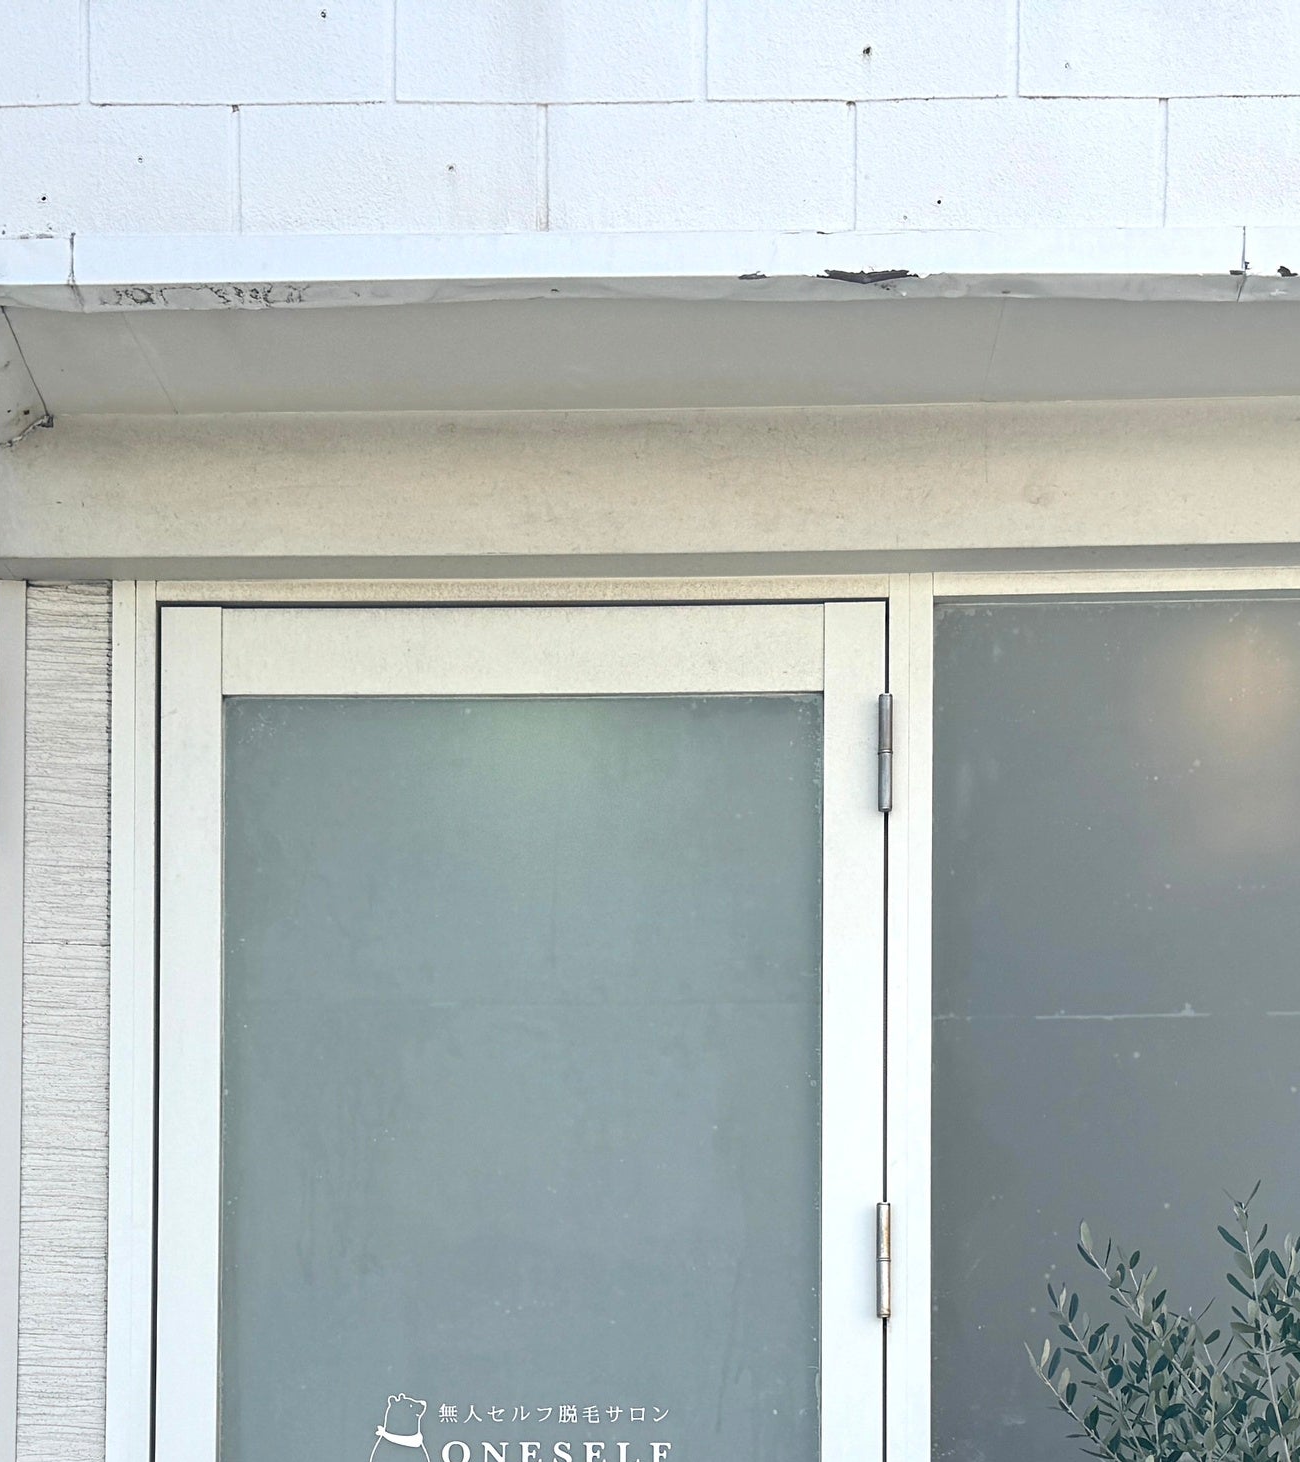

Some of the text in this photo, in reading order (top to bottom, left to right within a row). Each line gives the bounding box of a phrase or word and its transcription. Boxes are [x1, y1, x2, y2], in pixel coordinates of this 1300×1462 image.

[438, 1403, 670, 1424] 無人セルフ脱毛サロン
